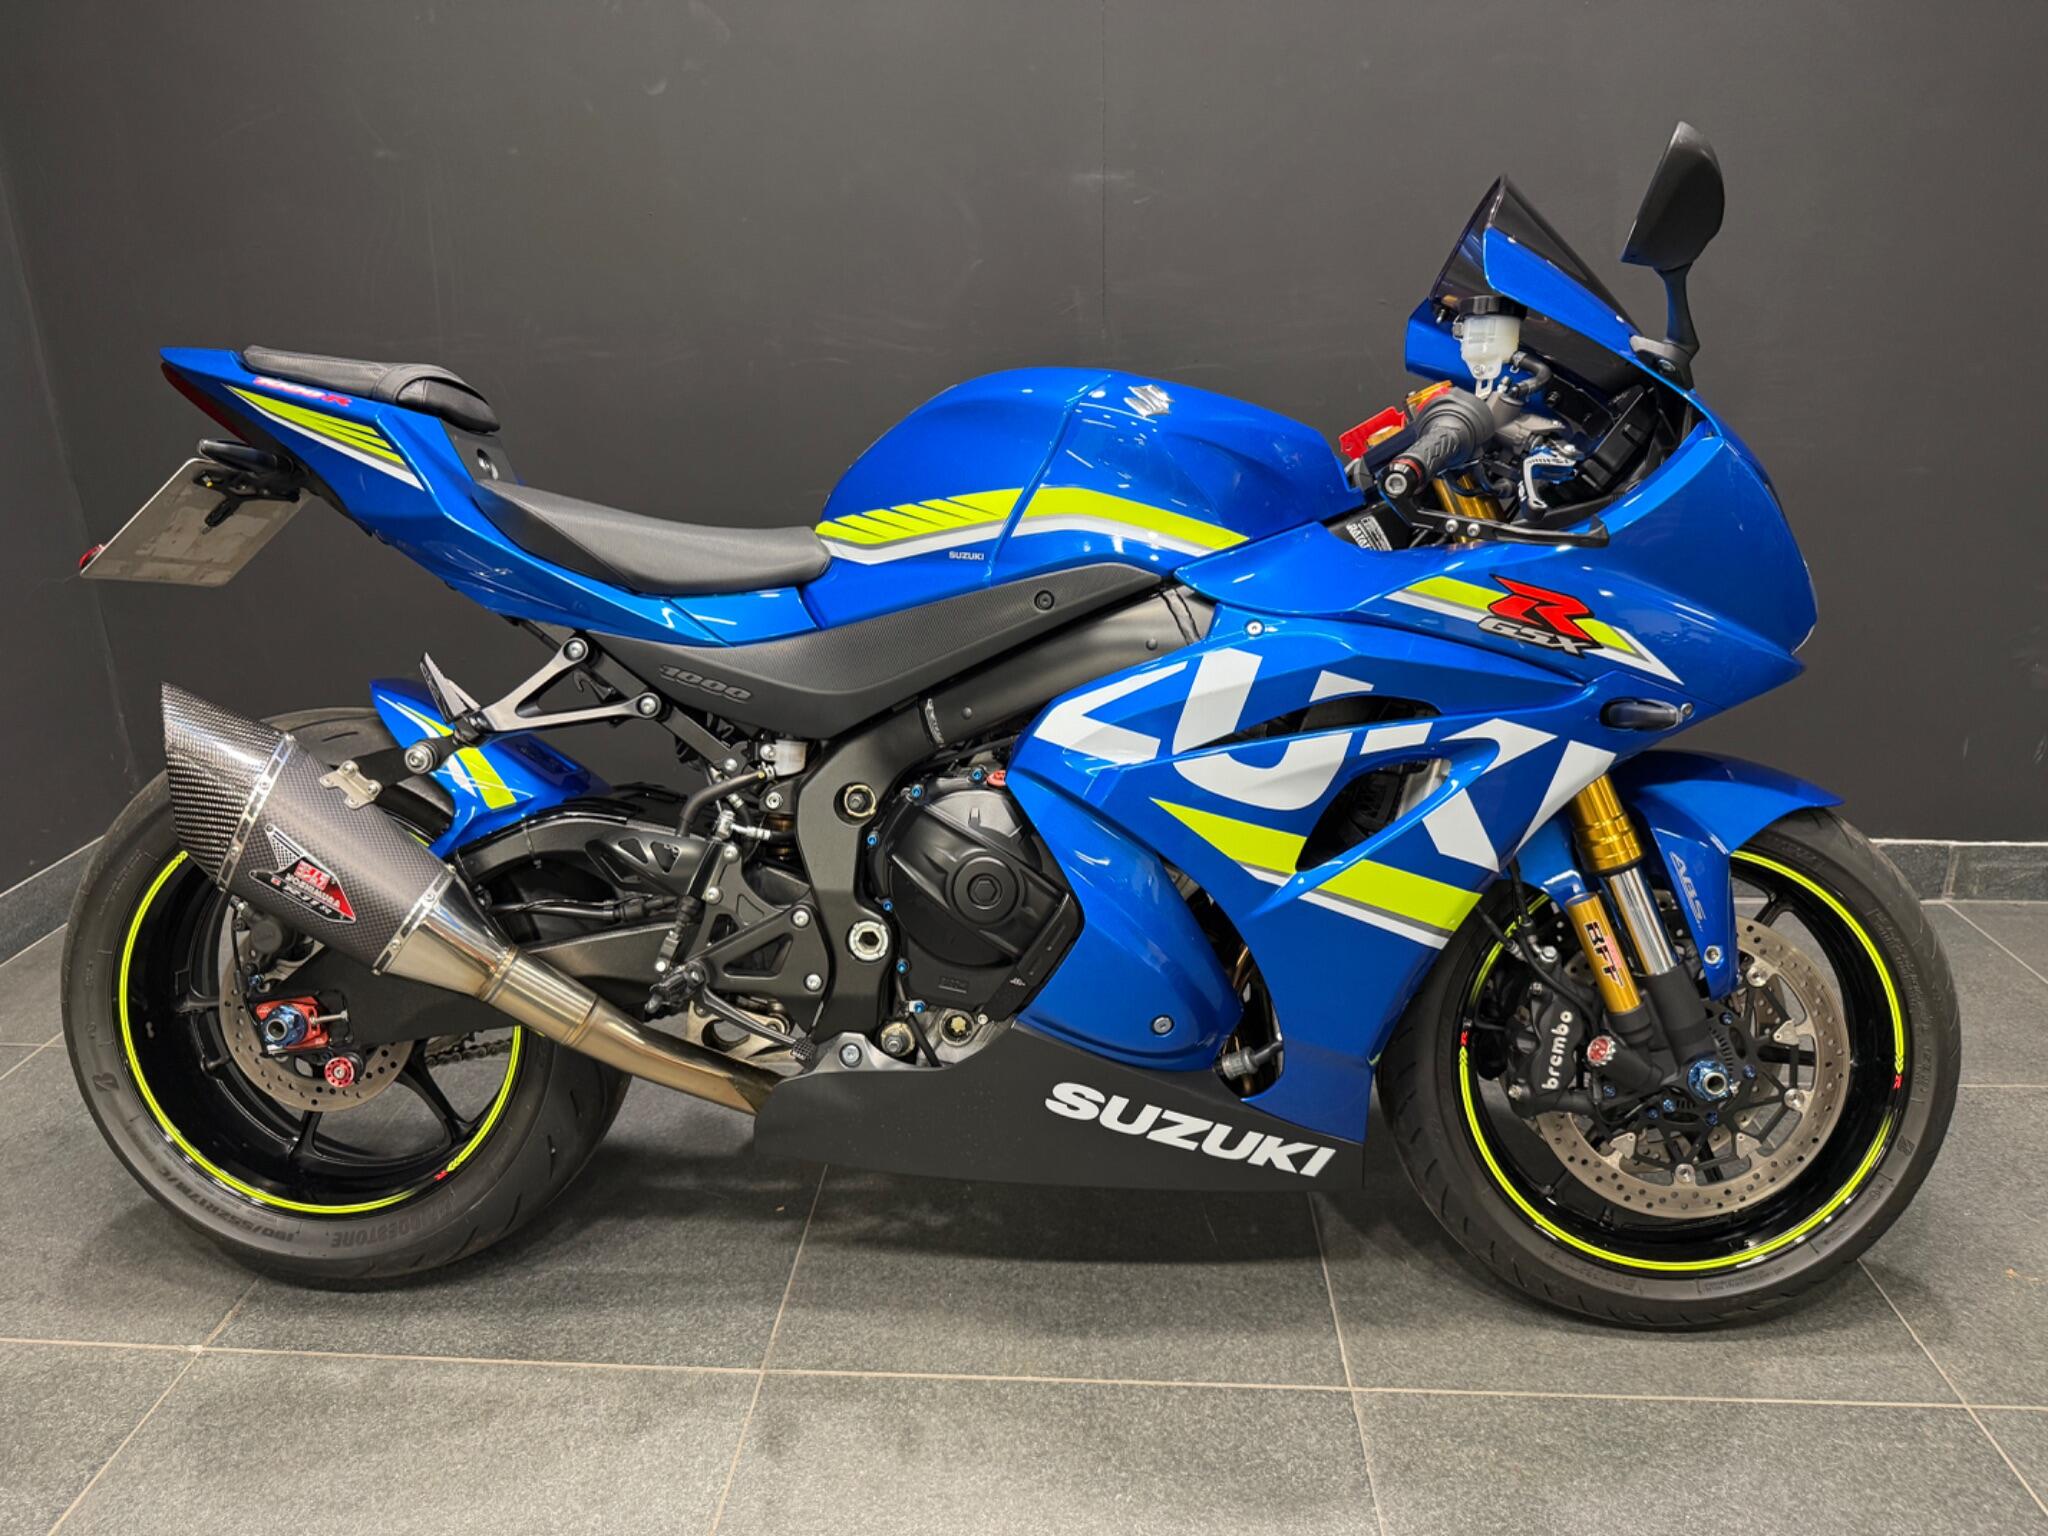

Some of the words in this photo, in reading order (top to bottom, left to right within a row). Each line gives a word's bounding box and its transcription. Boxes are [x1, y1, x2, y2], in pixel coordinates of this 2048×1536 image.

[949, 551, 985, 561] SUZUKI
[1478, 617, 1592, 655] GSX
[1489, 574, 1595, 642] R
[659, 664, 754, 702] 1000
[1669, 851, 1706, 921] ABS
[1541, 1010, 1573, 1090] brembo
[1045, 1082, 1337, 1177] SUZUKI
